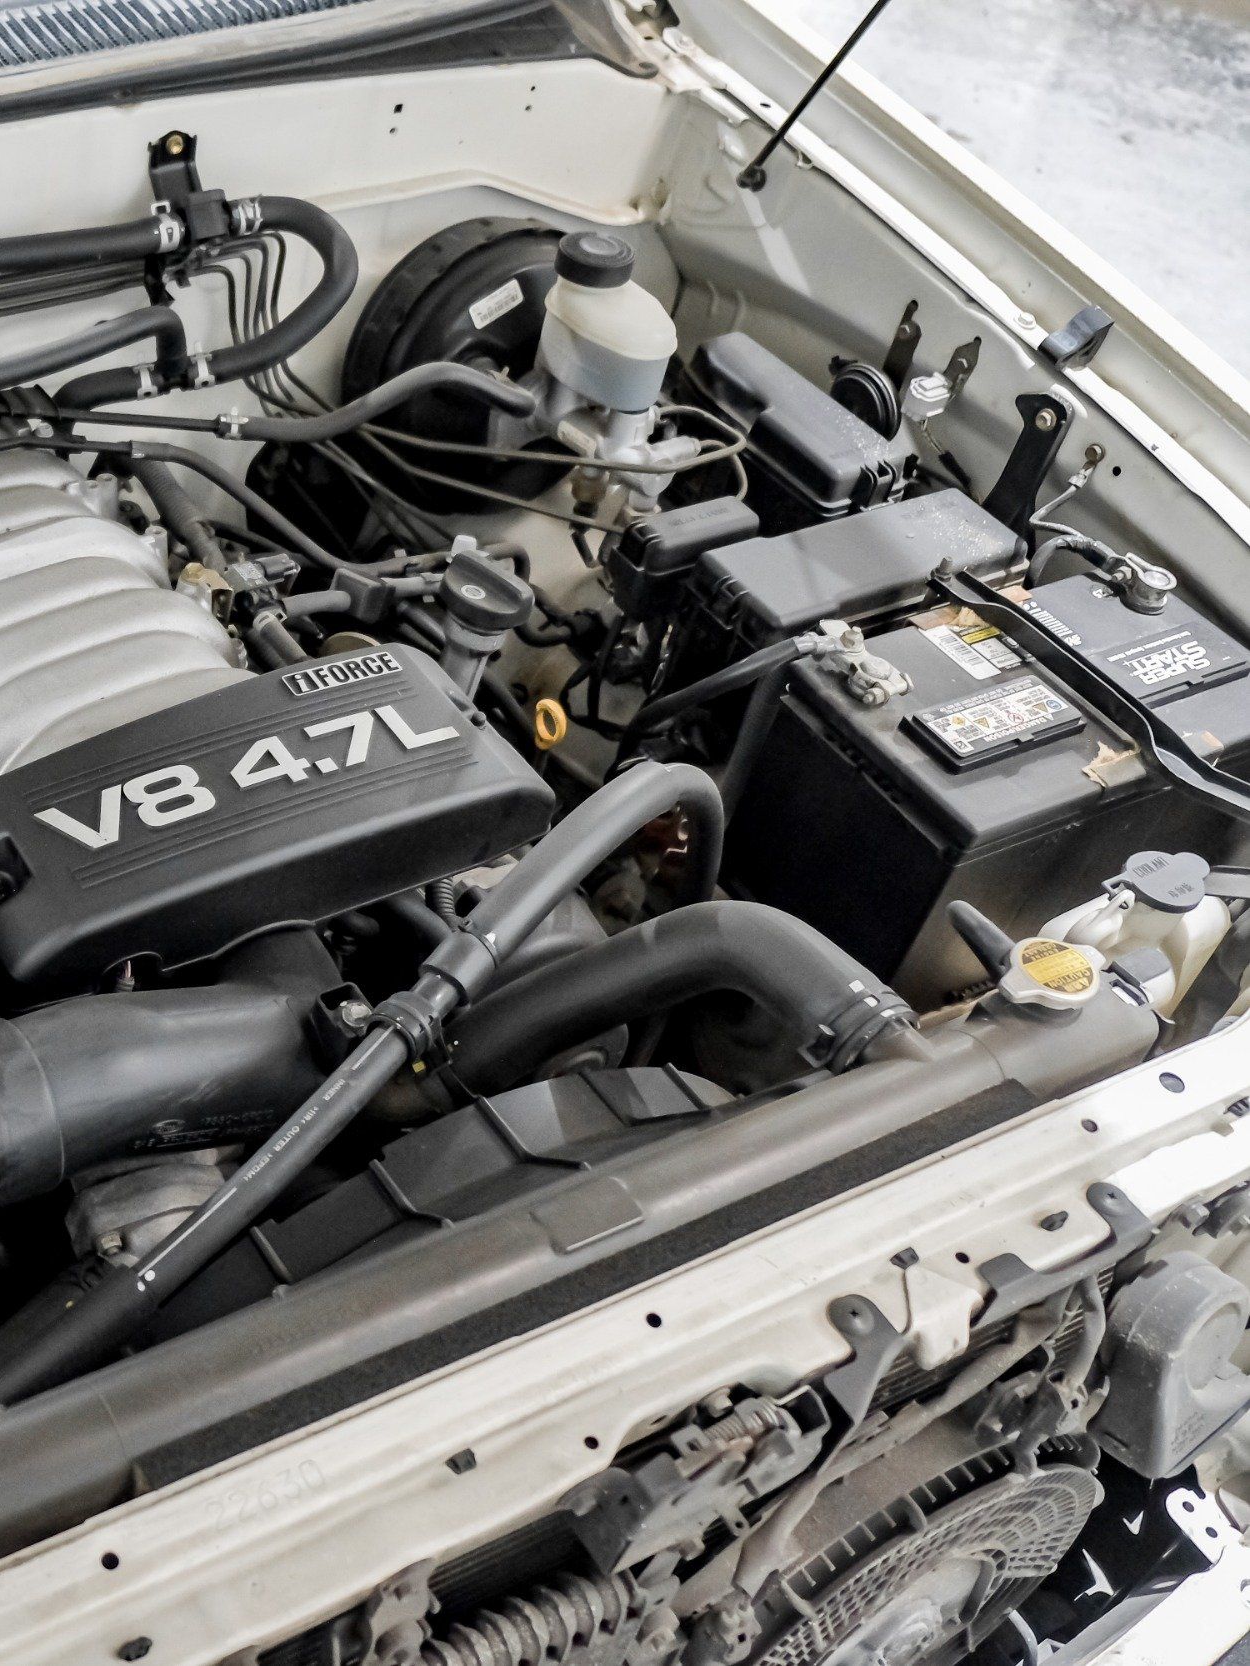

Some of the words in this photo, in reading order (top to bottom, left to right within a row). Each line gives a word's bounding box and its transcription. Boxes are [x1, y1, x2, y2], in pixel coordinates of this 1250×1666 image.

[1129, 640, 1208, 677] START
[1137, 655, 1212, 685] SUPER
[33, 763, 216, 849] V8
[230, 704, 461, 790] 4.7L
[322, 1078, 347, 1101] INNER
[272, 1125, 301, 1152] OUTER
